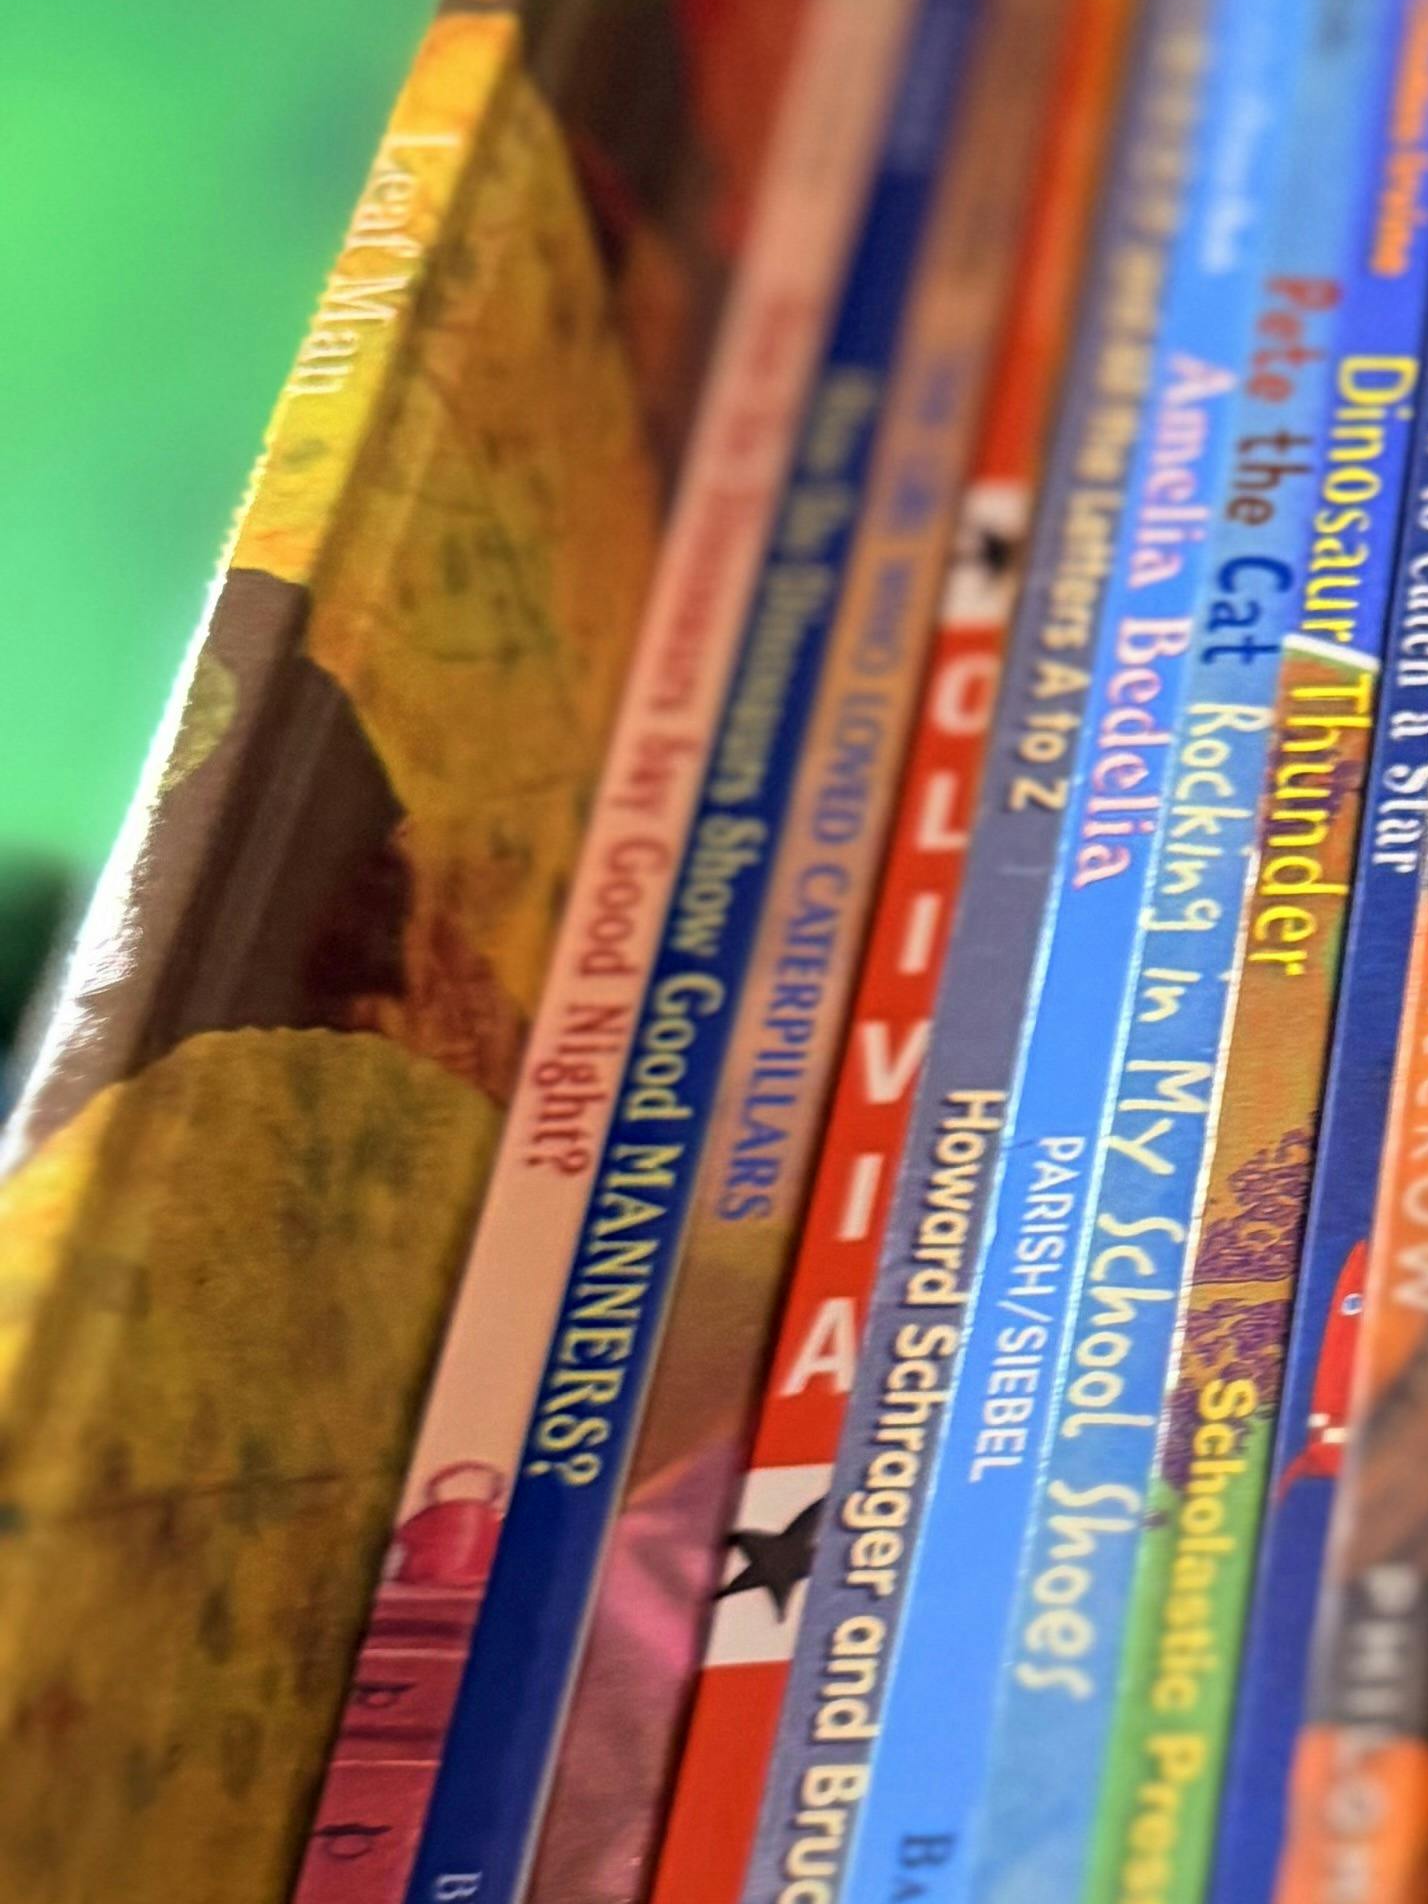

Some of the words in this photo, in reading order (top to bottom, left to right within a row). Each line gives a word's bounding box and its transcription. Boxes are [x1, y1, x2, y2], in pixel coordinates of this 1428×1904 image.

[348, 132, 462, 259] Leaf
[285, 274, 410, 398] Man
[1246, 274, 1343, 405] Pete
[1128, 350, 1240, 590] Amelia
[1224, 431, 1314, 528] the
[1300, 354, 1419, 645] Dinosaur
[1031, 660, 1092, 701] A
[1201, 556, 1295, 666] Cat
[1008, 776, 1069, 813] Z
[1015, 710, 1082, 764] to
[1072, 616, 1195, 889] Bedelia
[1137, 702, 1274, 938] Rocking
[1247, 672, 1375, 976] Thunder
[578, 835, 670, 980] Good
[674, 807, 769, 957] Show
[522, 1004, 628, 1178] Night?
[624, 972, 727, 1123] Good
[716, 864, 852, 1223] CATERPILLARS
[779, 653, 998, 1399] OLIVIA
[1099, 1059, 1214, 1176] My
[903, 1088, 1010, 1308] Howard
[525, 1141, 686, 1487] MANNERS?
[968, 1133, 1085, 1487] PARISH/SIEBEL
[1061, 1212, 1185, 1440] School
[842, 1316, 961, 1598] Schrager
[1146, 1376, 1260, 1713] Scholastic
[814, 1617, 885, 1744] and
[1012, 1479, 1142, 1701] Shoes
